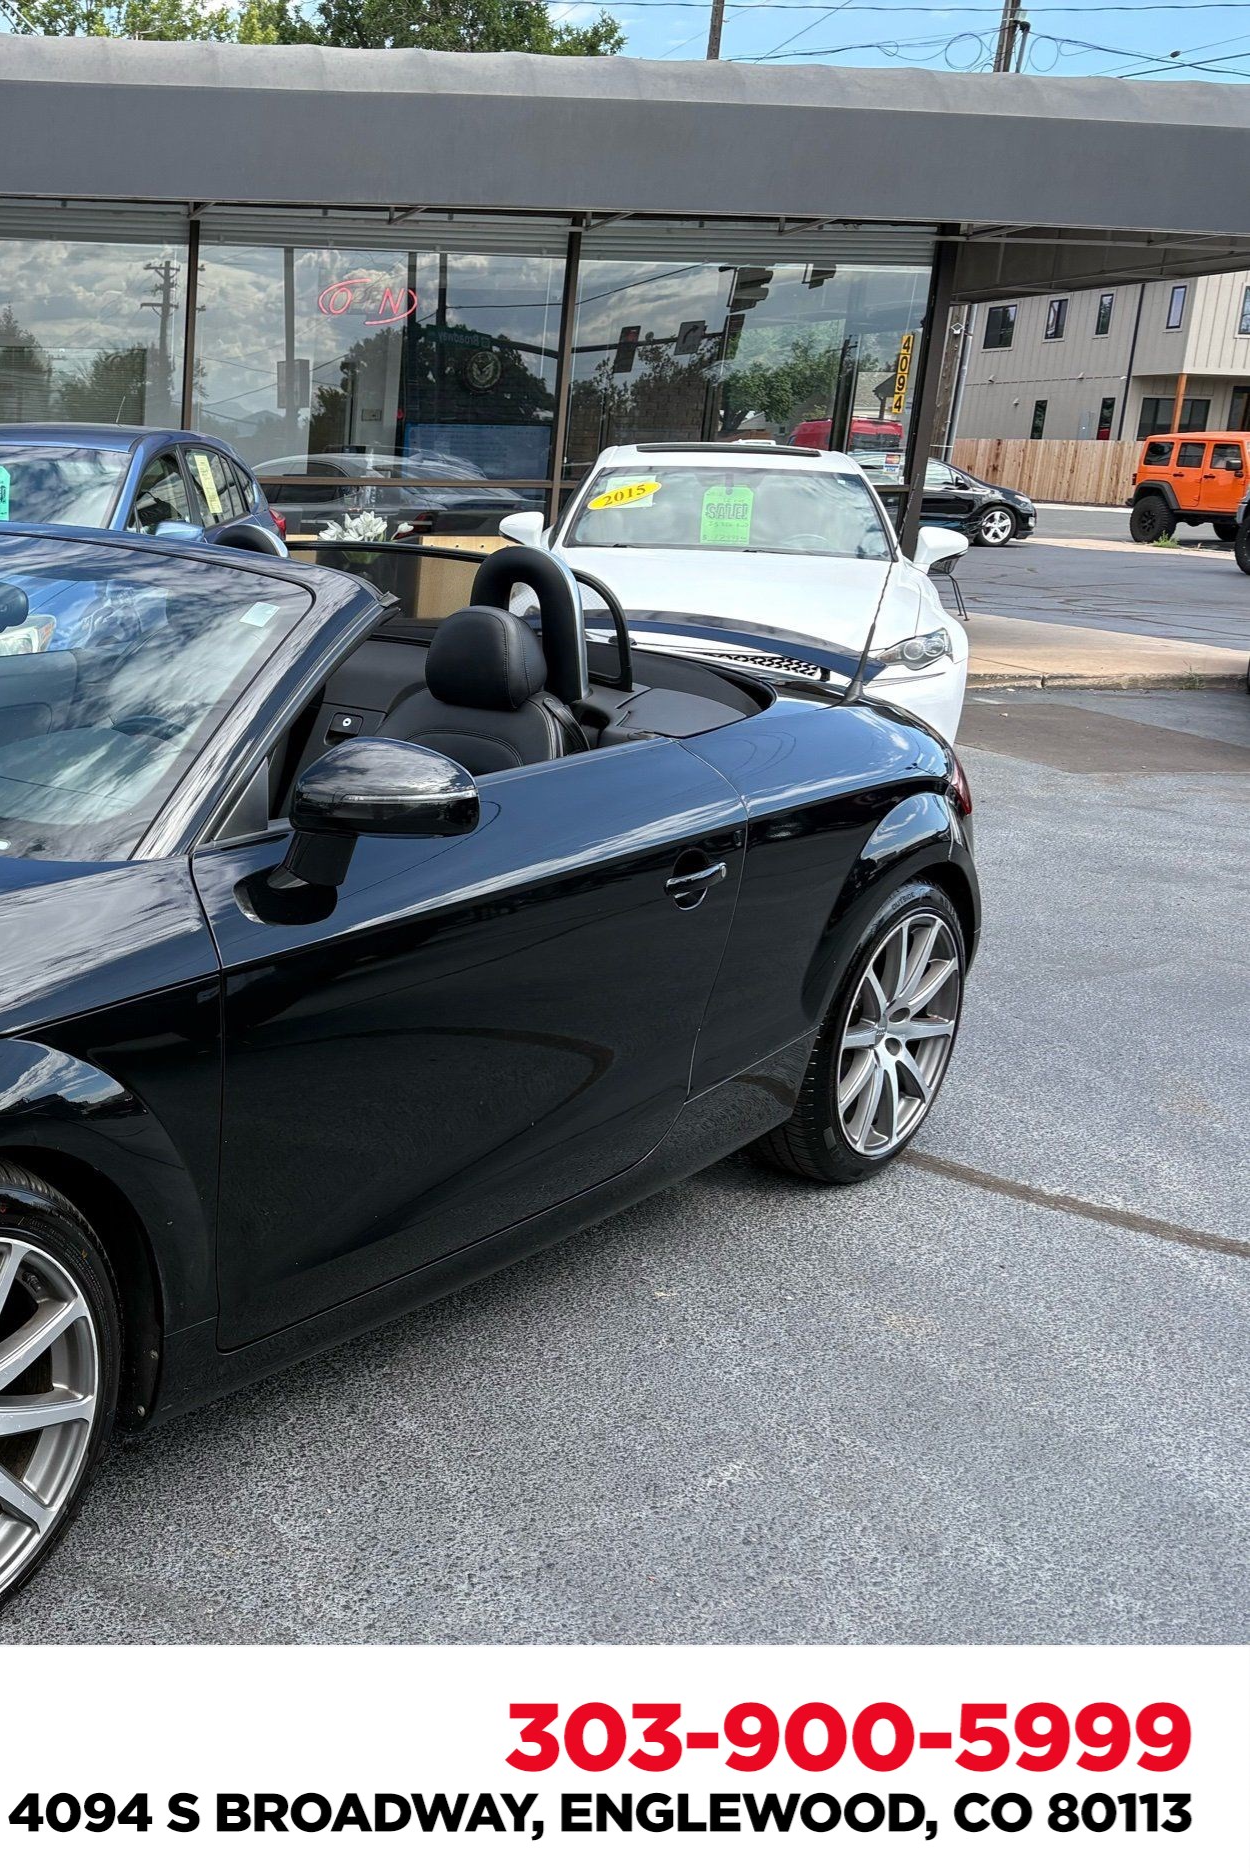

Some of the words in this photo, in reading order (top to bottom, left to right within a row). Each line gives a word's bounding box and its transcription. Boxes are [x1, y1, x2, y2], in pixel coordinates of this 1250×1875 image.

[329, 287, 406, 315] ON
[893, 335, 912, 413] 4094
[603, 484, 646, 506] 2015
